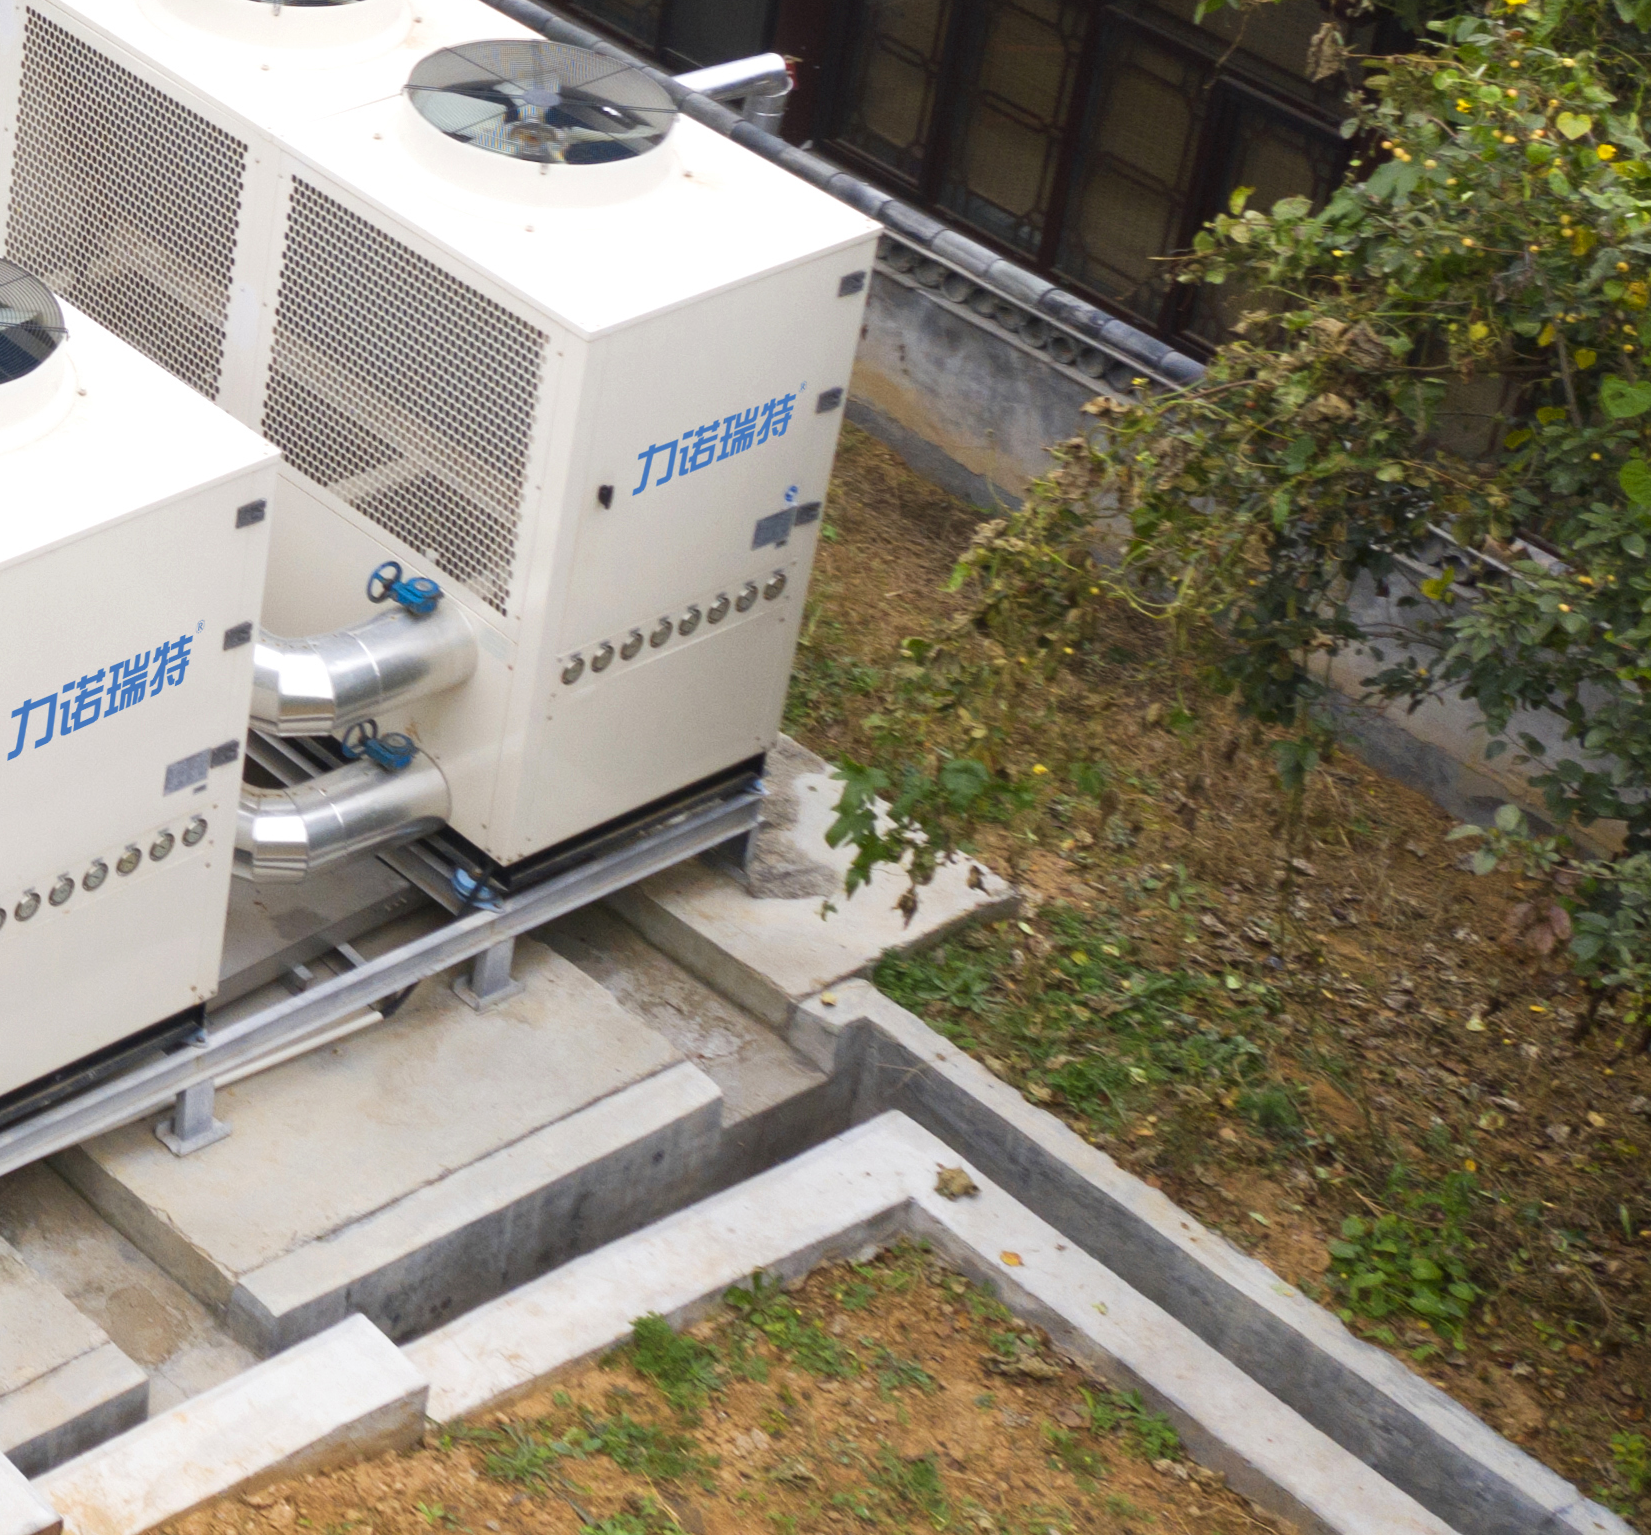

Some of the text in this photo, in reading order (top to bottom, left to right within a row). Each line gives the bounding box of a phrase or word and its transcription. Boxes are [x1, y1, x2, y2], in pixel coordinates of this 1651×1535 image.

[633, 393, 797, 496] 力诺瑞特
[7, 634, 194, 761] 力诺瑞特
